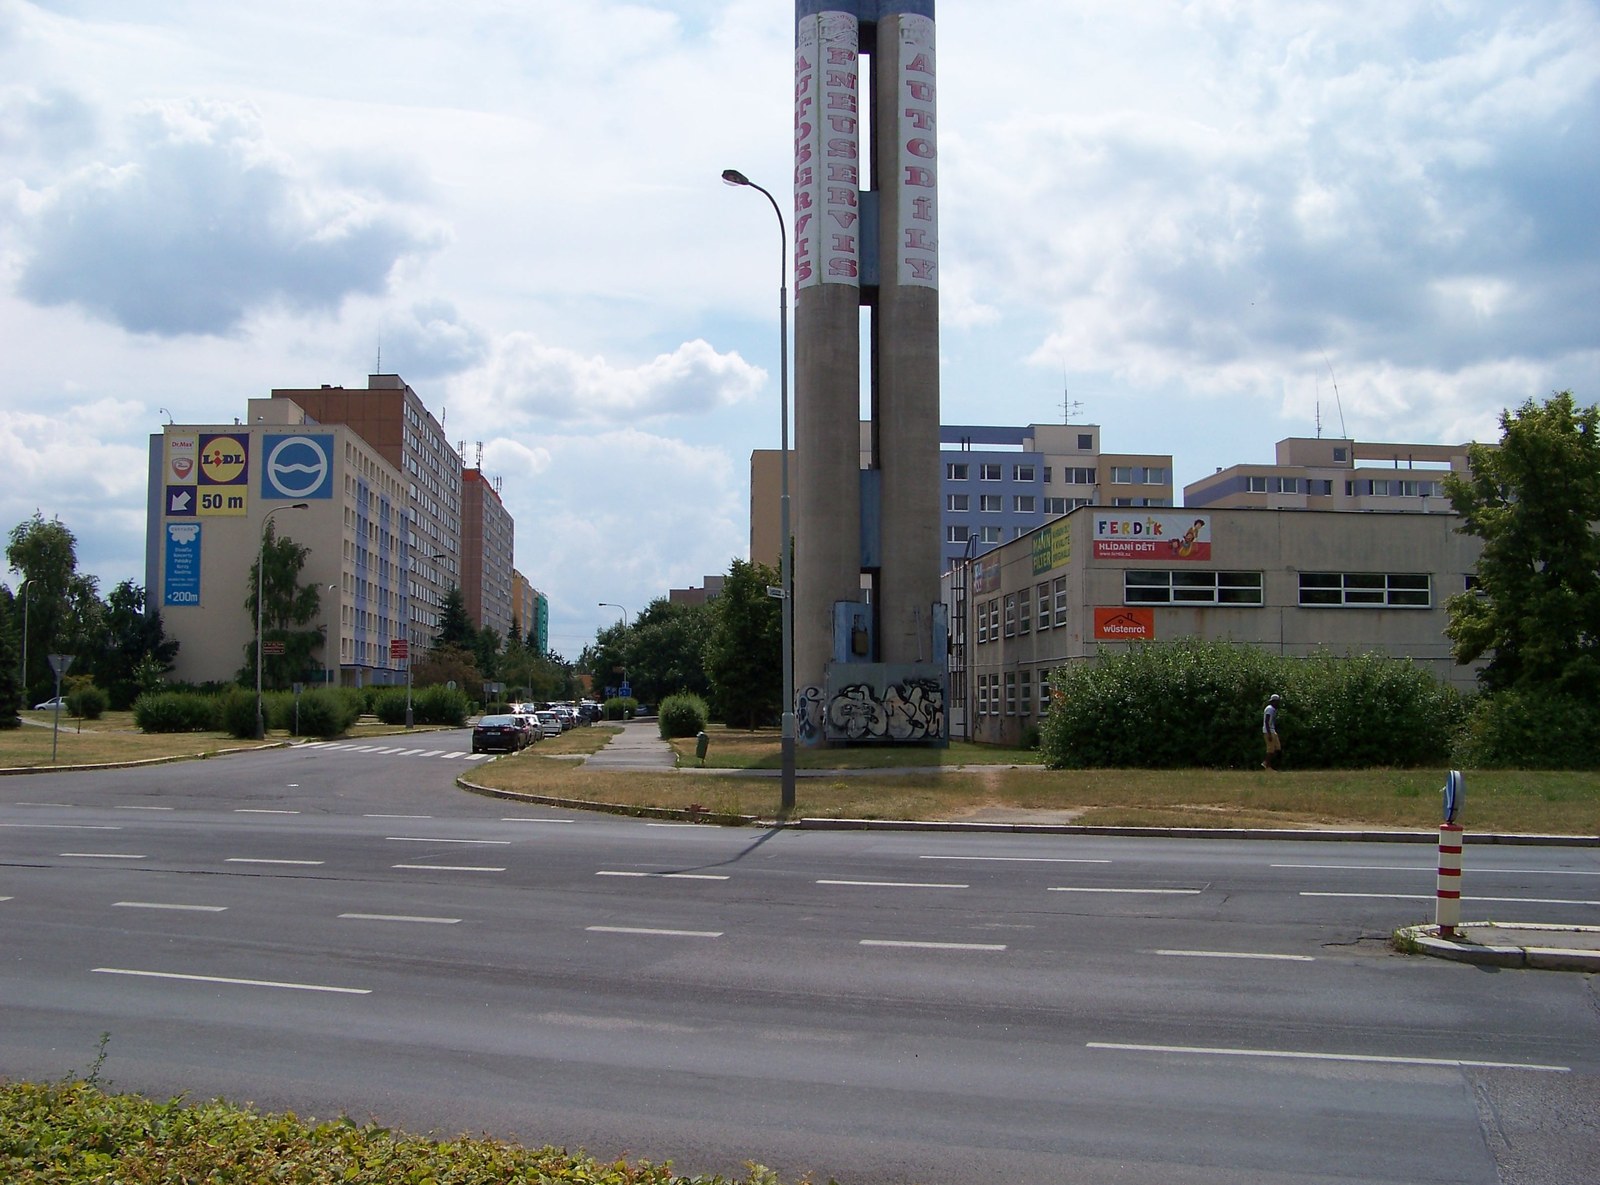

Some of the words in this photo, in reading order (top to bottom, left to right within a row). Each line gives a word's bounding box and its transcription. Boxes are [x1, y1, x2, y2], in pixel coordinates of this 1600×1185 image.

[826, 46, 857, 278] PNEUSERVIS
[202, 493, 223, 509] 50
[227, 496, 243, 509] m
[172, 591, 198, 602] 200m
[1103, 624, 1146, 634] wüstenrot
